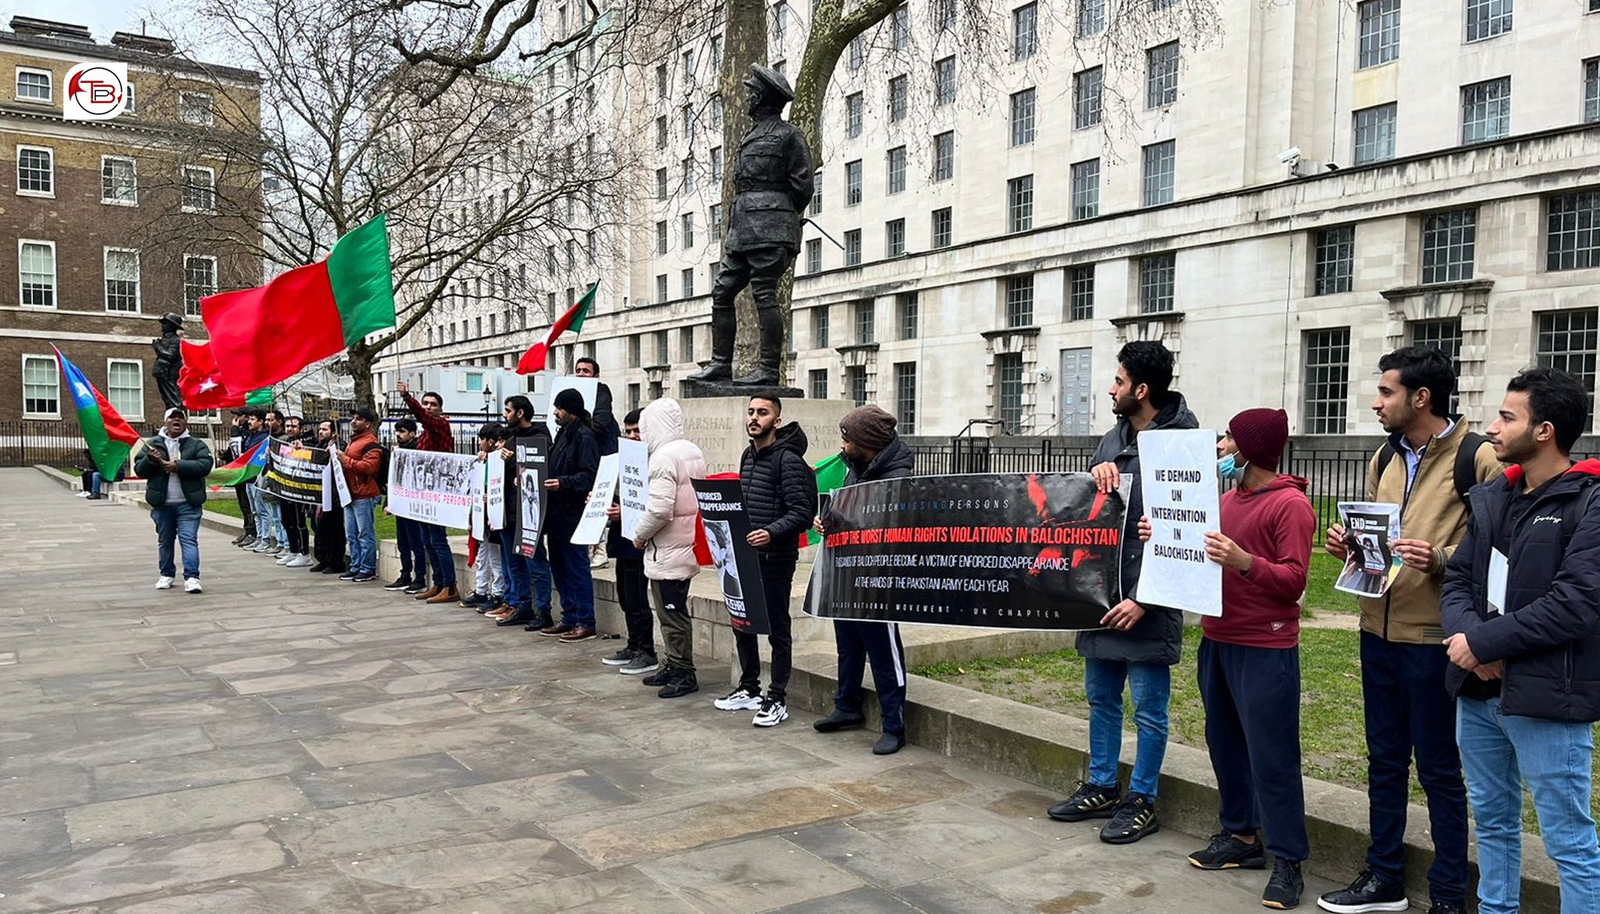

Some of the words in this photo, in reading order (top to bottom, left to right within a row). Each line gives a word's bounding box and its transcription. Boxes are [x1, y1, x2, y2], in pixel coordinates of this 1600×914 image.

[1155, 469, 1166, 482] WE
[1167, 469, 1202, 484] DEMAND
[421, 491, 441, 503] MISSING
[1171, 489, 1182, 502] UN
[1151, 506, 1207, 524] INTERVENTION
[1350, 517, 1365, 530] END
[849, 530, 860, 544] THE
[860, 528, 883, 544] WORST
[883, 527, 913, 543] HUMAN
[914, 526, 949, 543] RIGHTS
[949, 526, 1013, 543] VIOLATIONS
[1015, 527, 1029, 544] IN
[1030, 527, 1118, 546] BALOCHISTAN
[1173, 527, 1182, 541] IN
[1154, 544, 1205, 563] BALOCHISTAN
[875, 555, 893, 566] PEOPLE
[893, 554, 918, 567] BECOME
[918, 555, 925, 567] A
[925, 554, 948, 567] VICTIM
[948, 554, 958, 568] OF
[959, 554, 998, 569] ENFORCED
[998, 556, 1070, 571] DISAPPEARANCE
[887, 576, 894, 589] OF
[895, 576, 906, 589] THE
[940, 578, 963, 590] ARMY
[963, 578, 986, 592] EACH
[986, 579, 1010, 593] YEAR
[895, 604, 950, 614] MOVEMENT
[973, 607, 988, 616] UK
[998, 608, 1060, 619] CHAPTER
